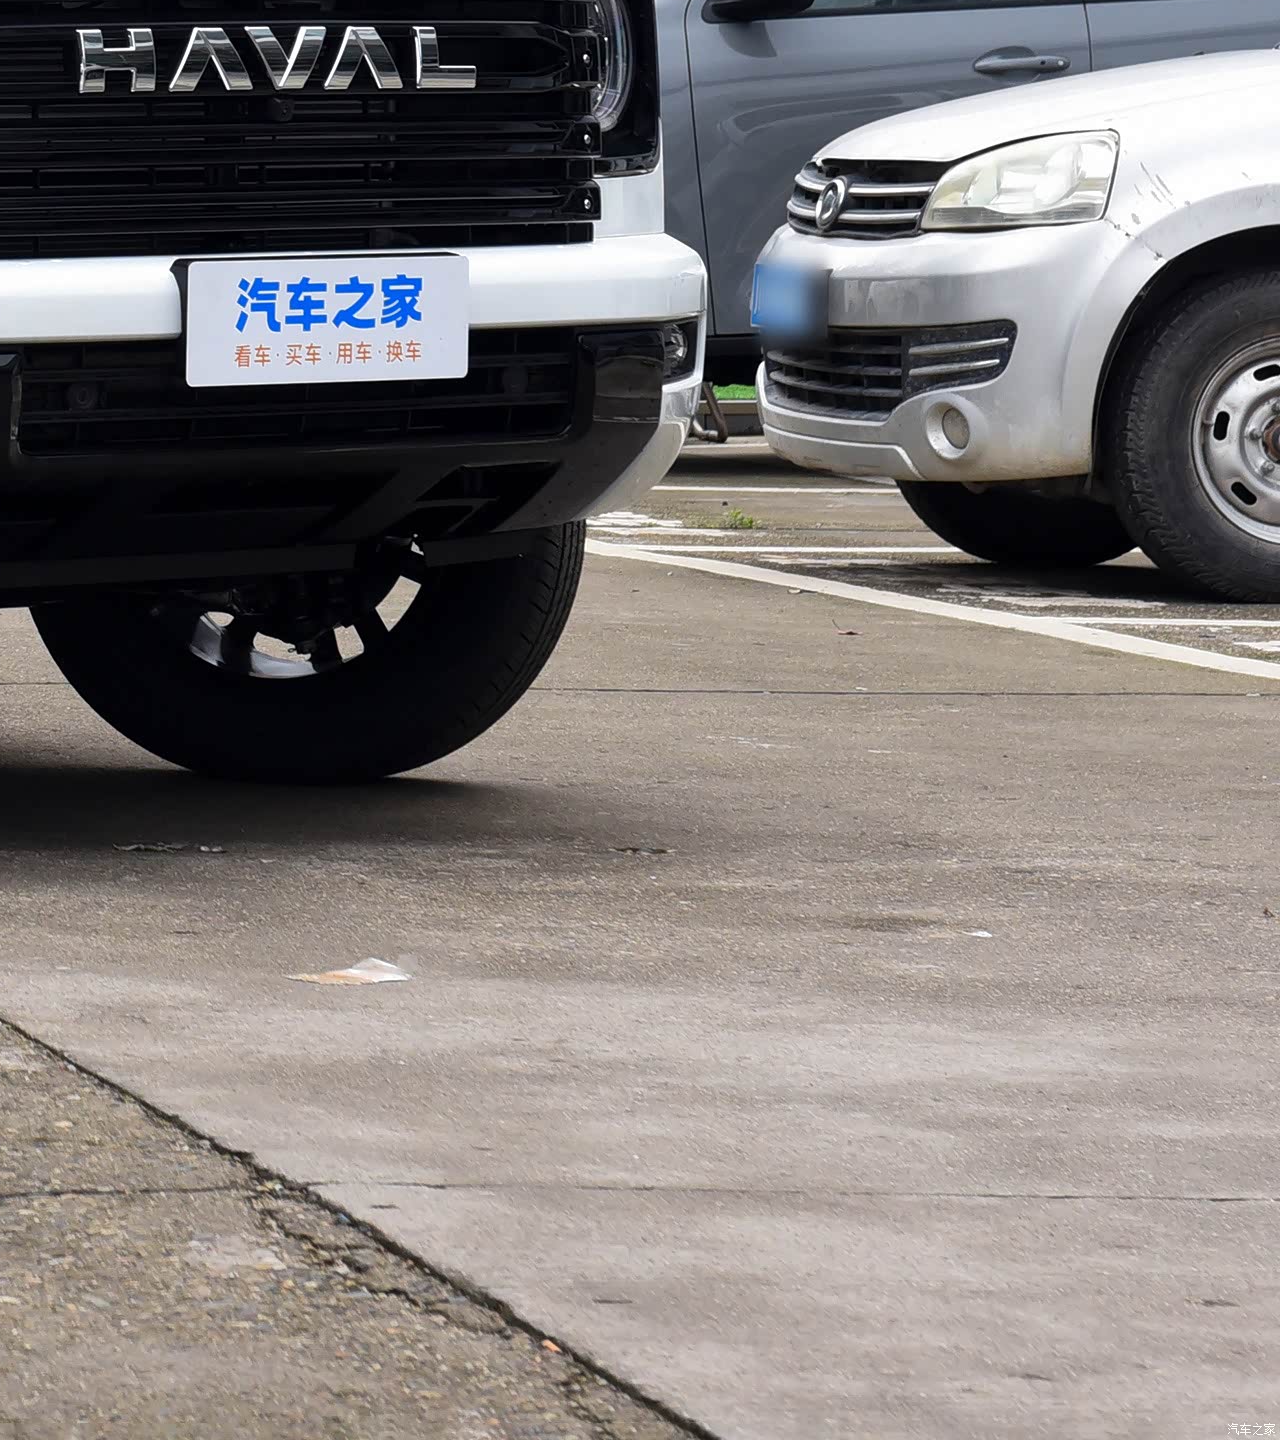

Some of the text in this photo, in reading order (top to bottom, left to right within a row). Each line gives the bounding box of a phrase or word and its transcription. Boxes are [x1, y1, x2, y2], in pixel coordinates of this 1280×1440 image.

[76, 26, 477, 93] HAVAL
[235, 274, 423, 333] 汽车之家
